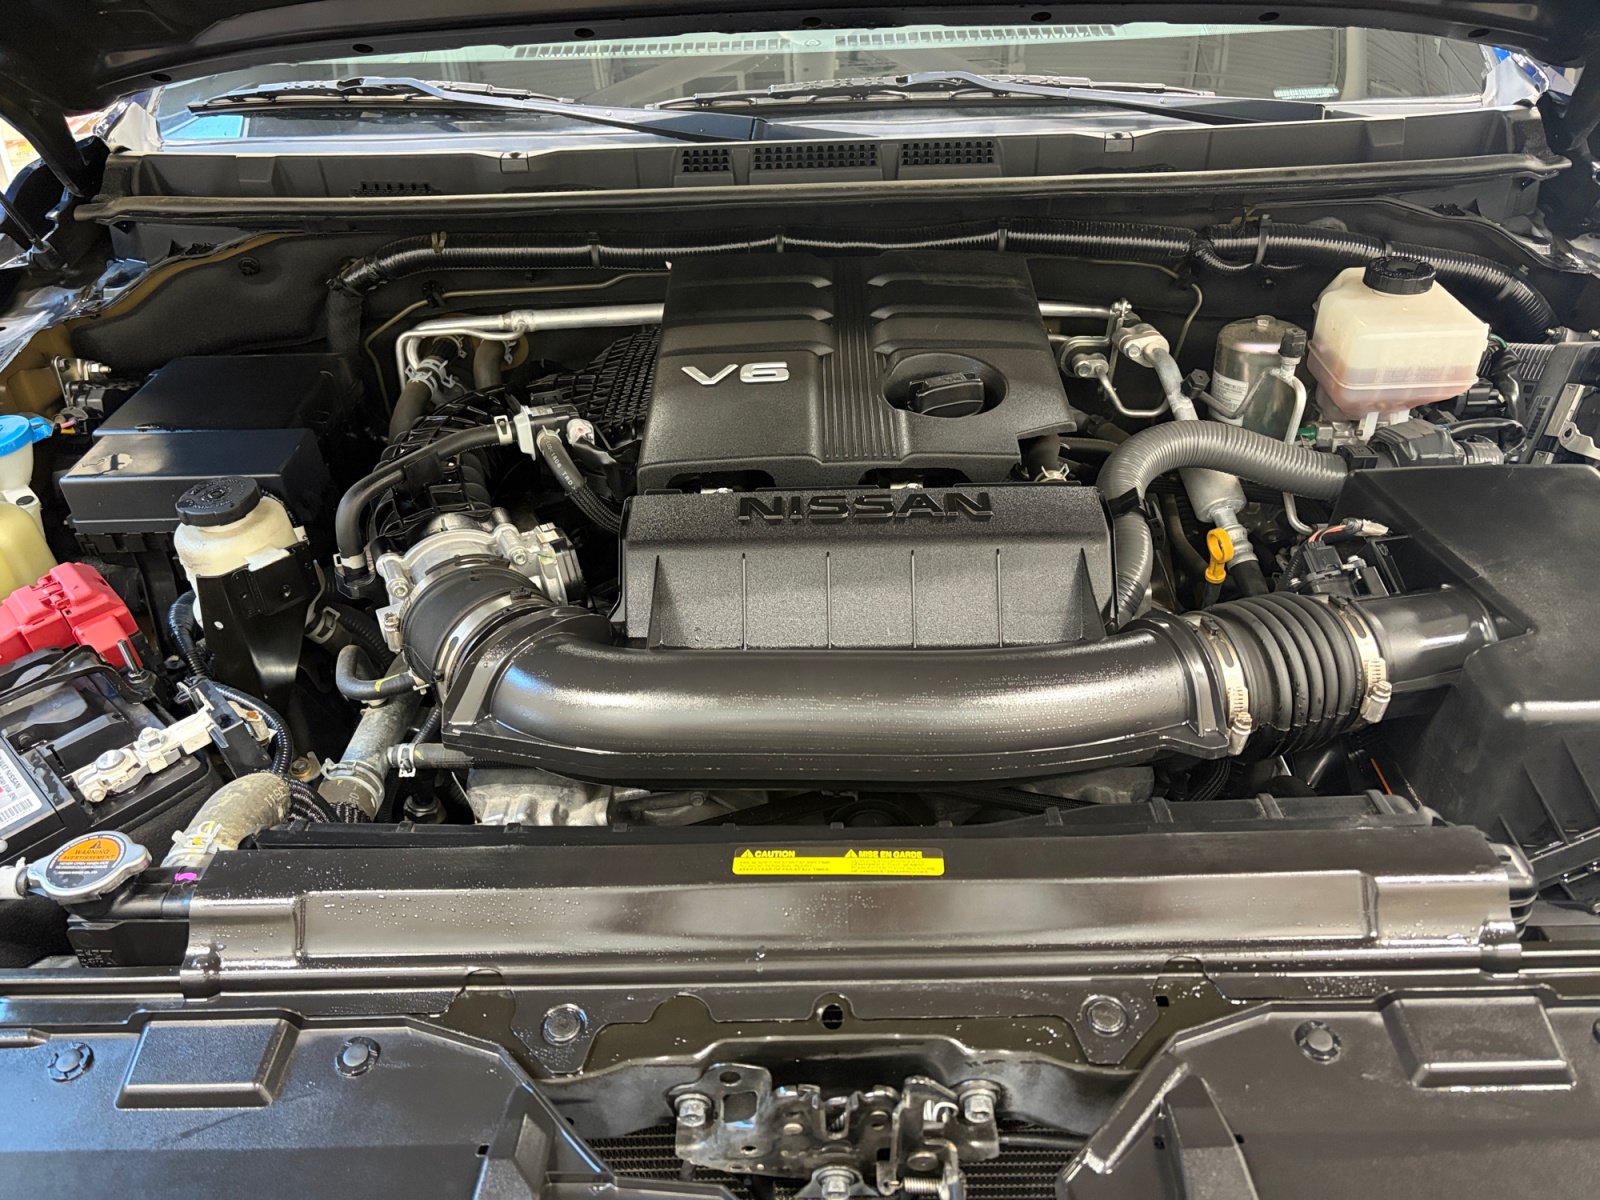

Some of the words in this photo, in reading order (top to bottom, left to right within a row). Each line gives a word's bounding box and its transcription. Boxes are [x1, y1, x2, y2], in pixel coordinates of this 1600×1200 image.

[681, 361, 790, 386] V6
[738, 492, 994, 521] NISSAN
[754, 850, 796, 858] CAUTION
[858, 850, 879, 859] MISE
[880, 850, 892, 859] EN
